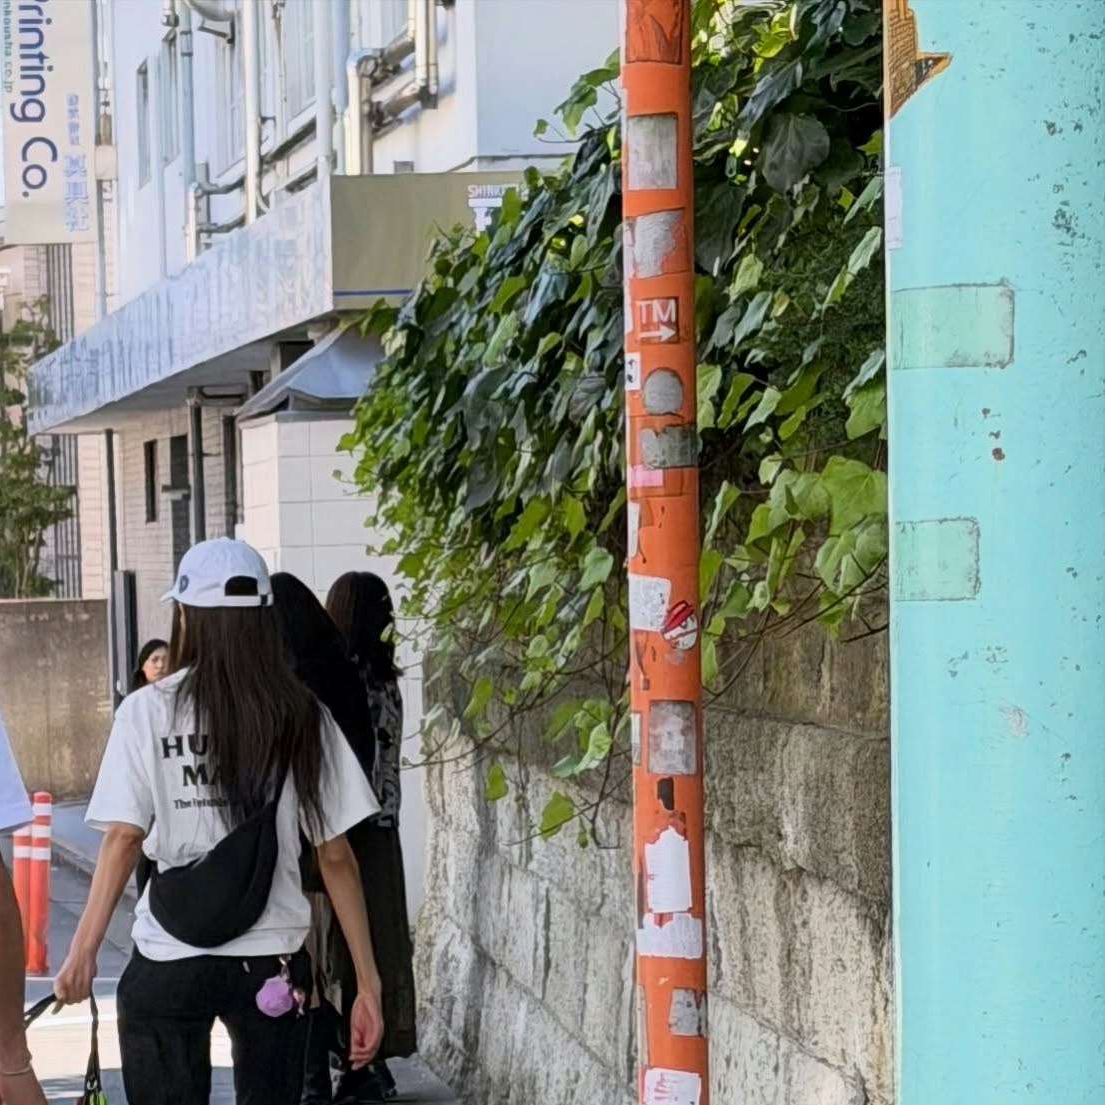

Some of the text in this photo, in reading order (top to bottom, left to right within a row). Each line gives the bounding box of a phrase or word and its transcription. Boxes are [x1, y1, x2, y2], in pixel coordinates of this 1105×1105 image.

[9, 0, 59, 198] rinting Co.
[639, 298, 677, 323] TM
[160, 734, 209, 759] HU
